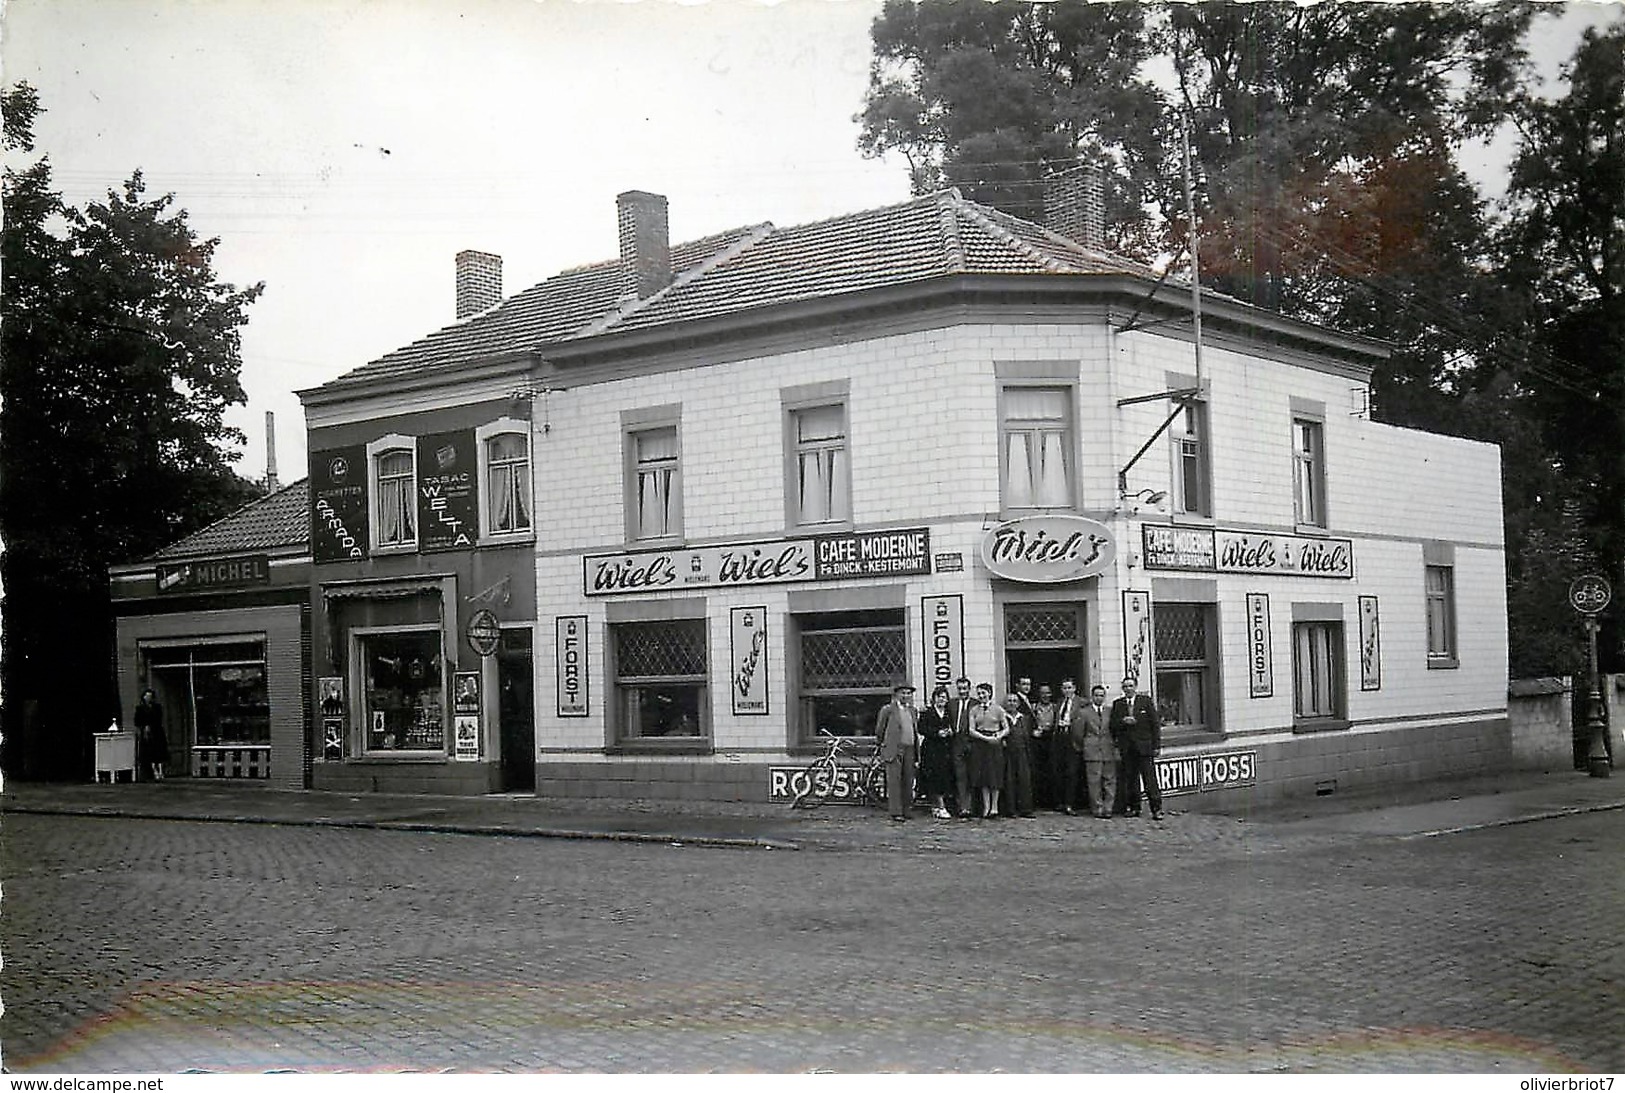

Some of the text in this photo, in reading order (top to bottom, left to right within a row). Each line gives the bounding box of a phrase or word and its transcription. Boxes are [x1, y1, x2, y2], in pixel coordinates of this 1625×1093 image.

[316, 499, 363, 558] ARMADA
[421, 485, 471, 546] WELTA
[718, 546, 809, 583] Wiel's
[820, 534, 924, 562] CAFE MODERNE
[991, 527, 1108, 566] Wiel's
[1221, 536, 1276, 568] Wiel's
[1299, 543, 1349, 572] Wiel's
[197, 561, 263, 582] MICHEL
[594, 556, 676, 590] Wiel's
[933, 620, 951, 685] FORS
[1254, 615, 1266, 682] FORST
[565, 638, 578, 703] FORST
[1203, 754, 1255, 784] ROSSI
